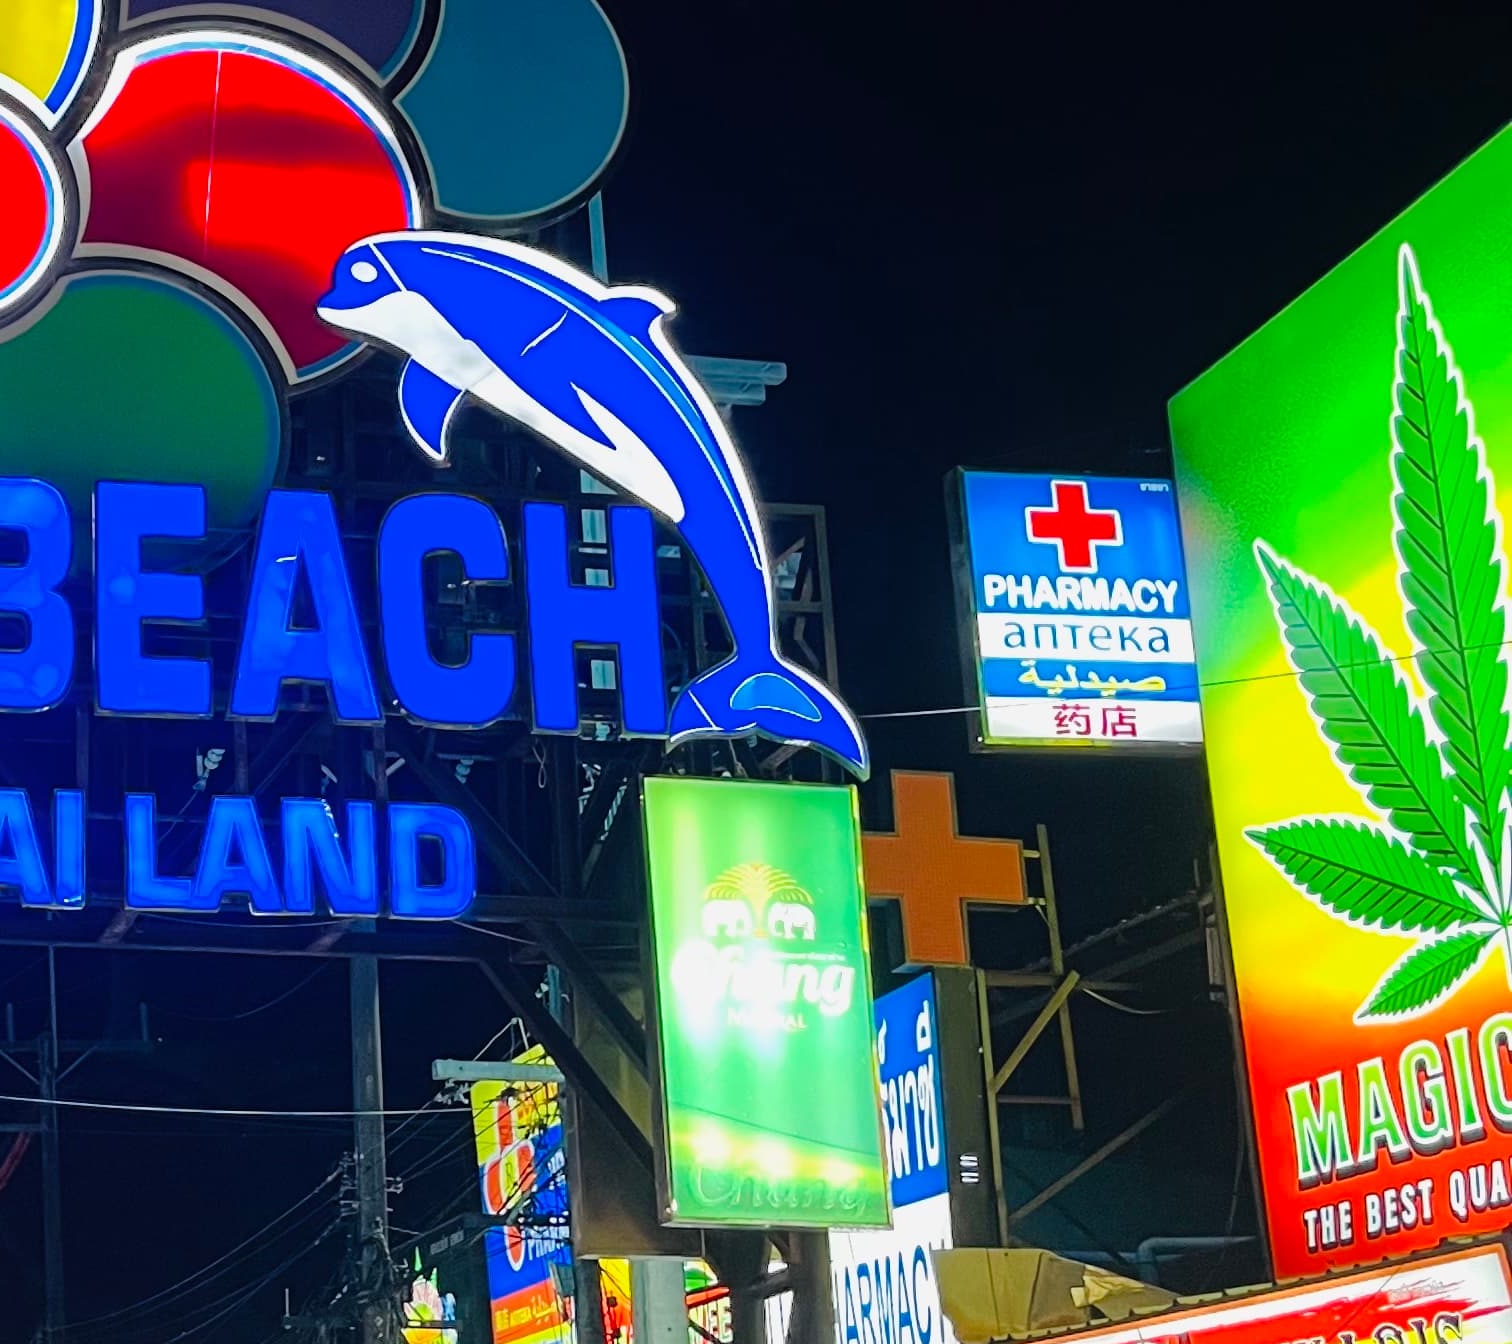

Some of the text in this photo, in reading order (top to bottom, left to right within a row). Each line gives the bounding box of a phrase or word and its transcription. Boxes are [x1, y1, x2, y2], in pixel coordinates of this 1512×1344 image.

[983, 574, 1178, 613] PHARMACY
[1002, 621, 1171, 654] аптека
[1052, 703, 1138, 738] 药店
[1285, 1011, 1512, 1190] MAGIC
[1303, 1156, 1512, 1253] THE BEST QUA
